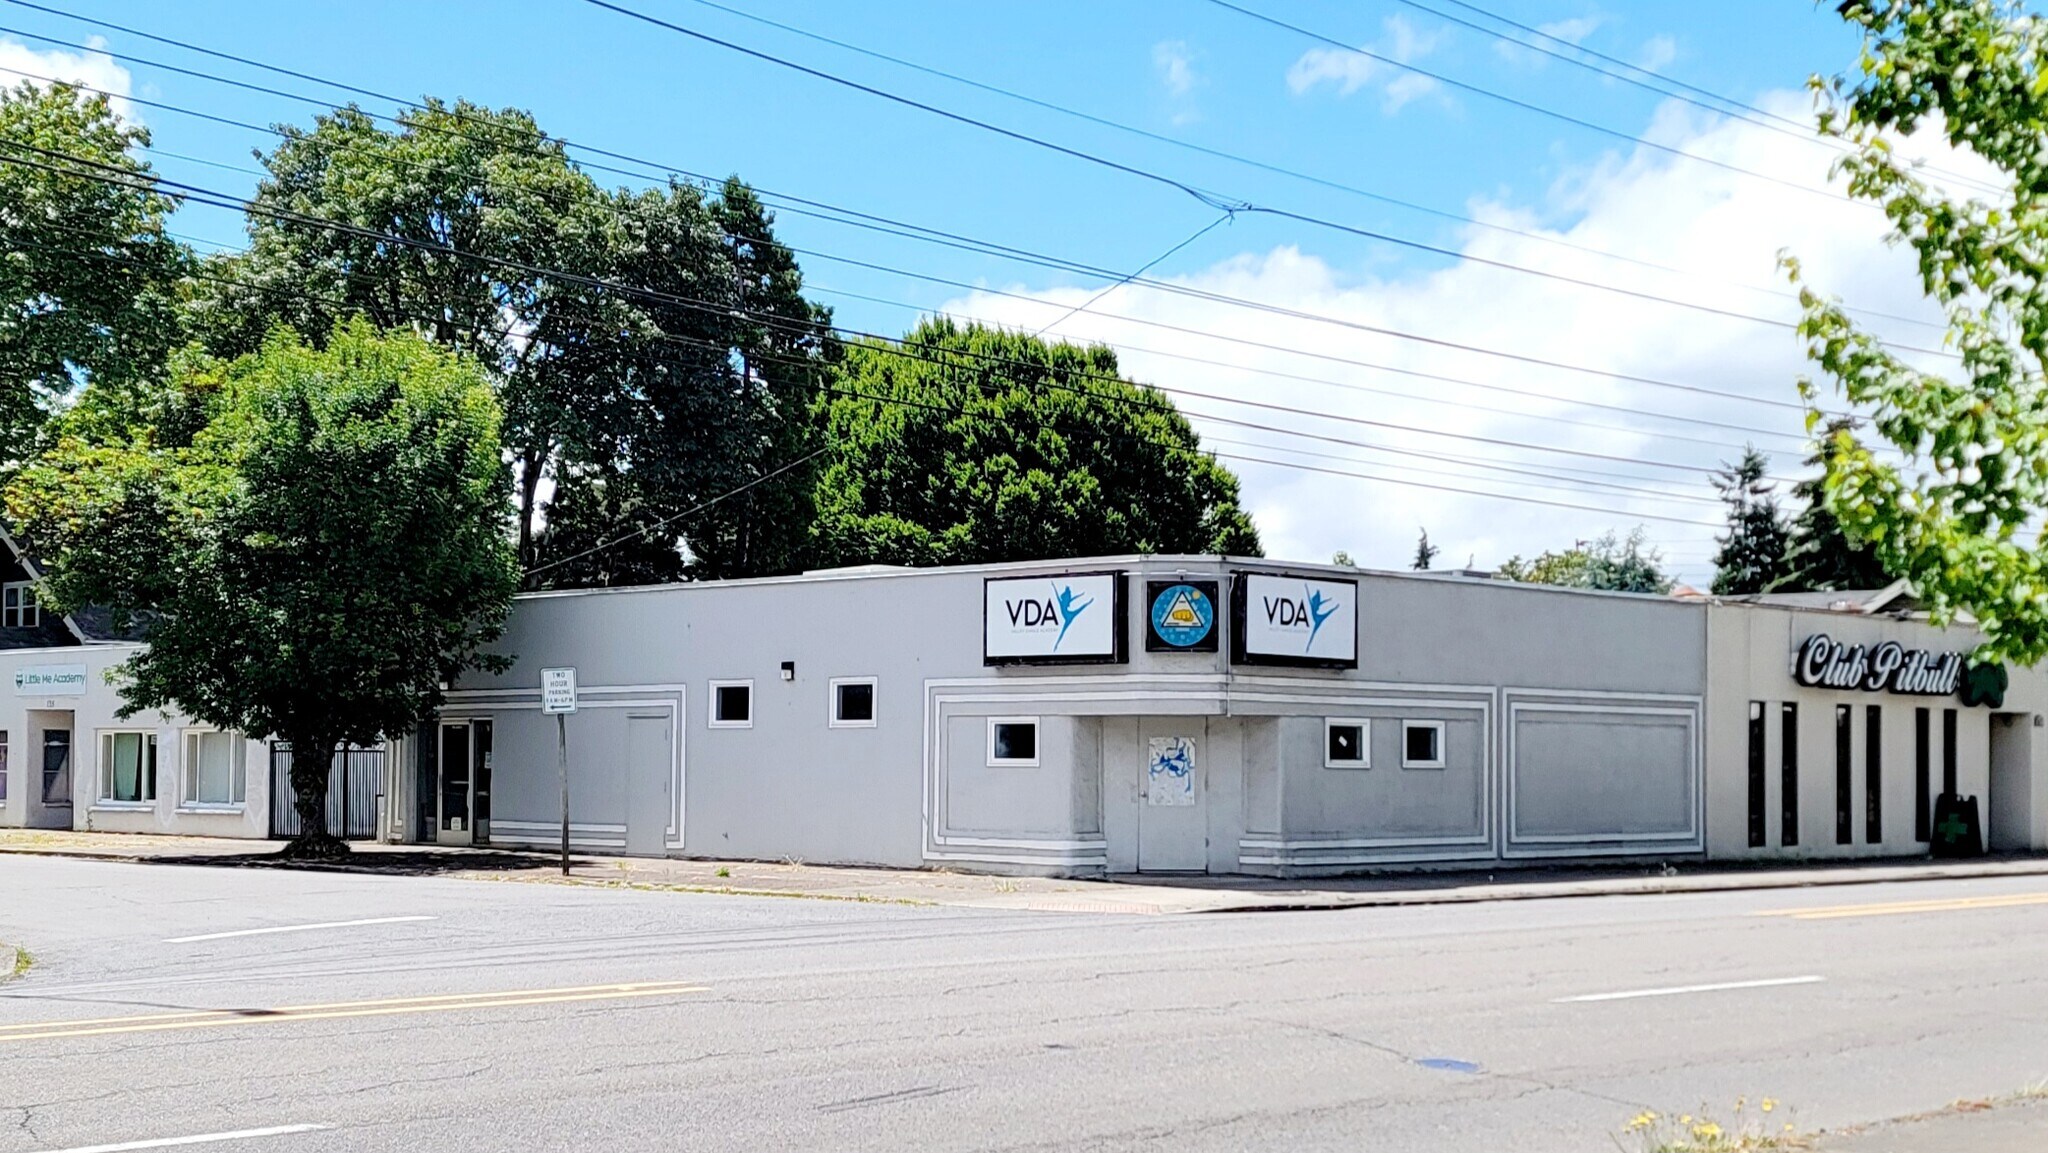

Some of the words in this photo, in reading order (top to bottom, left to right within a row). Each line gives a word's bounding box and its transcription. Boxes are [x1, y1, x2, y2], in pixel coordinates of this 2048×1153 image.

[1005, 598, 1059, 628] VDA
[1263, 596, 1310, 628] VDA
[24, 674, 41, 684] Little
[42, 673, 52, 684] Me
[53, 673, 86, 685] Academy
[1801, 634, 1868, 688] Club
[1867, 641, 1963, 694] Pitbull
